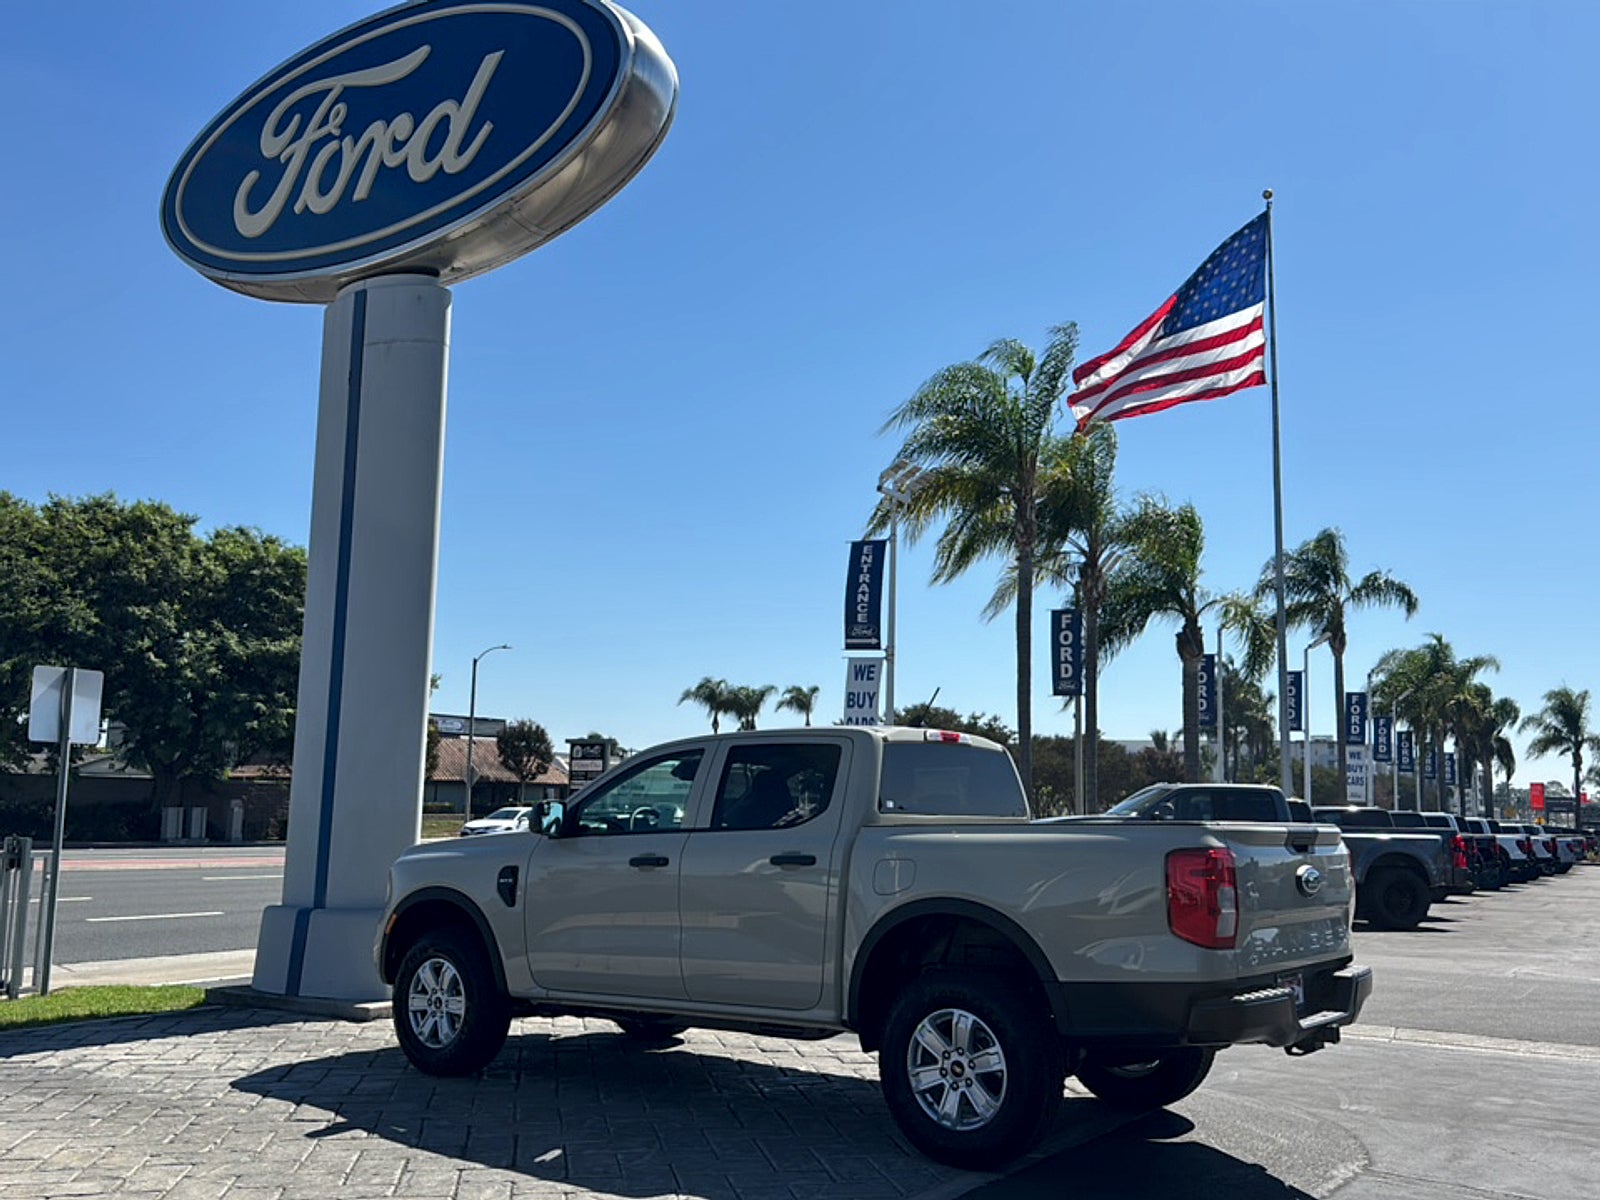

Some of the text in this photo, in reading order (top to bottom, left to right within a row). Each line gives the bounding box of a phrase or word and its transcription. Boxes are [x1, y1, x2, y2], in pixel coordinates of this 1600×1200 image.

[233, 44, 504, 238] Ford
[856, 545, 872, 623] ENTRANCE
[1059, 613, 1073, 678] FORD
[853, 664, 876, 681] WE
[847, 692, 876, 709] BUY
[1350, 695, 1360, 735] FORD
[1378, 718, 1387, 753] FORD
